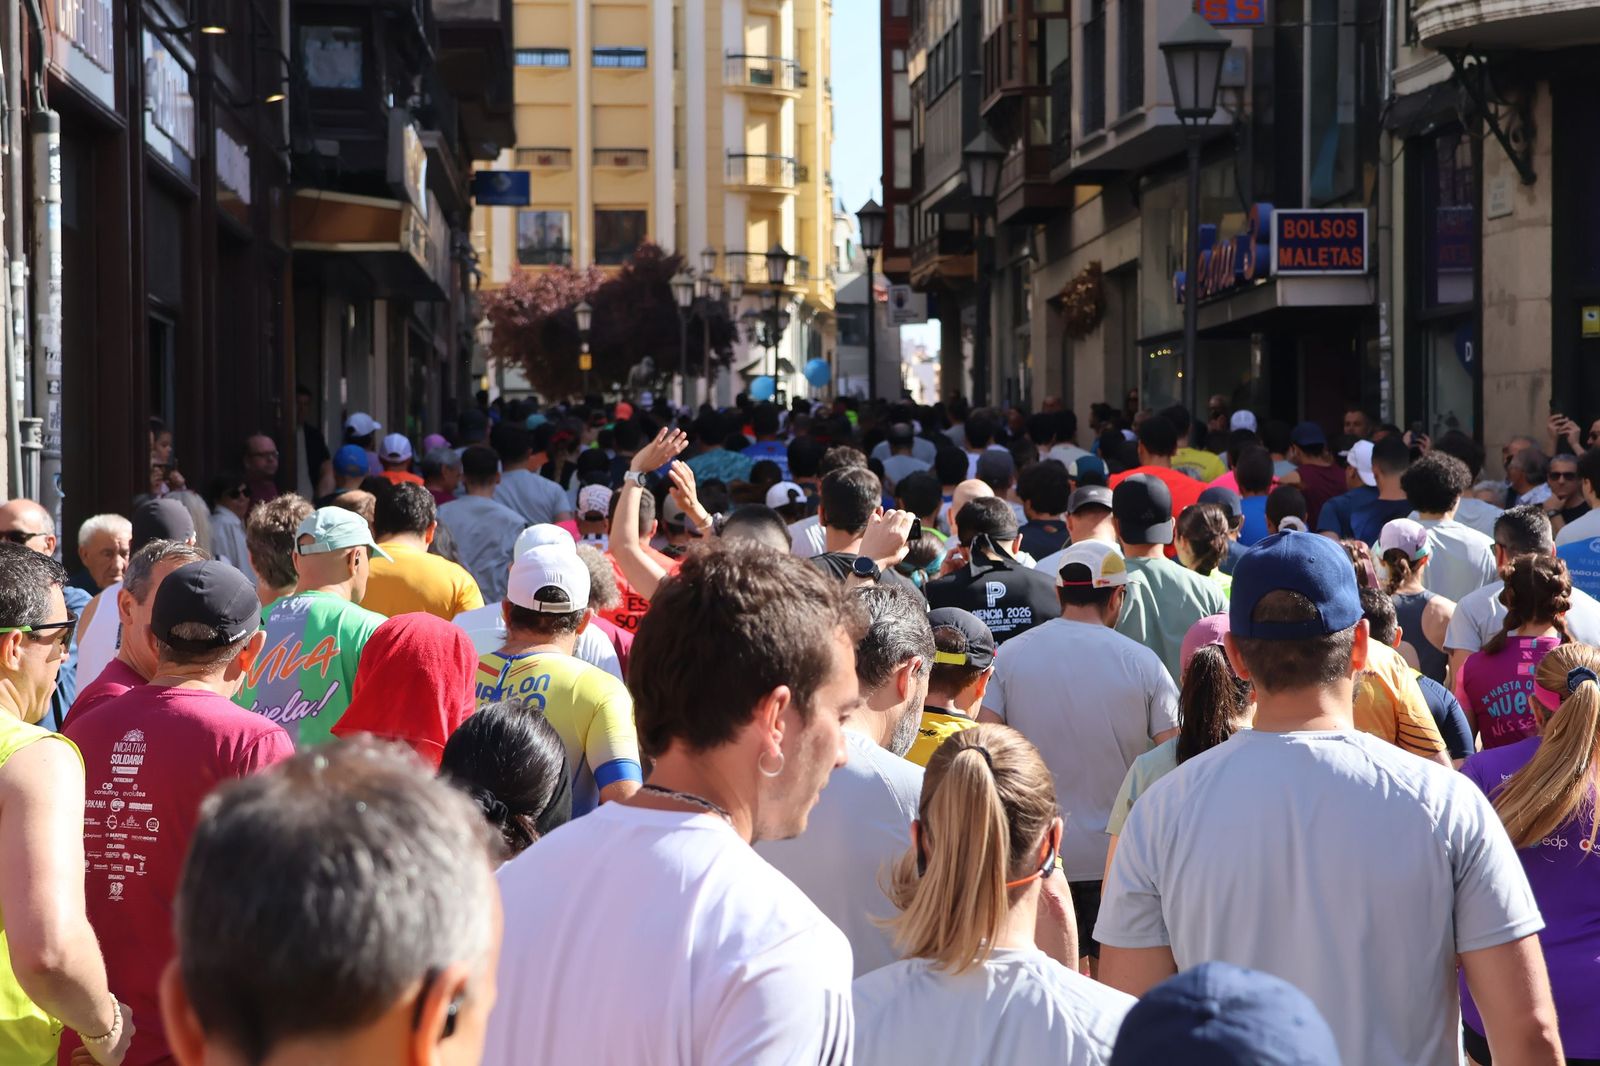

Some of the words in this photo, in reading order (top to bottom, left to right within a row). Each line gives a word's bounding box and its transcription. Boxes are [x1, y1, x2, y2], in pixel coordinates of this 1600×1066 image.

[1283, 219, 1357, 239] BOLSOS
[1279, 247, 1363, 267] MALETAS
[1007, 607, 1031, 618] 2026
[615, 614, 640, 629] SO
[238, 632, 340, 699] VILA
[1490, 680, 1521, 699] HASTA
[113, 742, 147, 753] INICIATIVA
[110, 754, 144, 766] SOLIDARIA
[1542, 835, 1568, 850] edp
